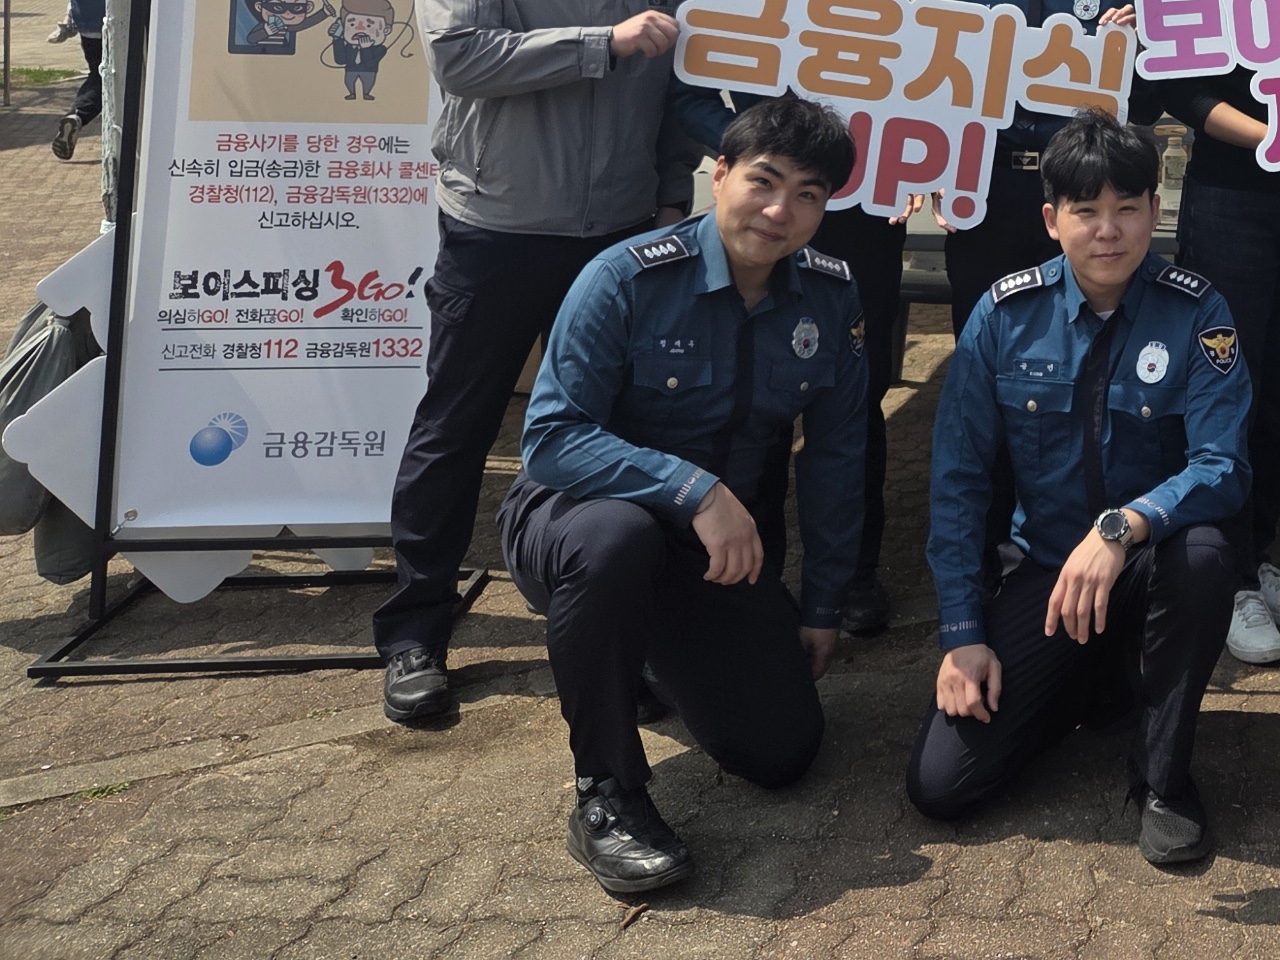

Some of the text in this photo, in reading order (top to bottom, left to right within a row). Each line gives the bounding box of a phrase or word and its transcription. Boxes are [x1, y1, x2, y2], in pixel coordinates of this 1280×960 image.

[215, 133, 411, 154] 금융사기를 당한 경우에는
[167, 158, 220, 179] 신속히
[227, 158, 321, 180] 입금(송금)한
[326, 160, 392, 180] 금융회사
[188, 183, 429, 207] 경찰청(112), 금융감독원(1332)에
[257, 210, 361, 231] 신고하십시오.
[168, 267, 320, 302] 보이스피싱
[156, 308, 229, 325] 의심하GO!
[340, 307, 409, 325] 확인하GO!
[160, 342, 217, 361] 신고전화
[262, 429, 387, 459] 금융감독원
